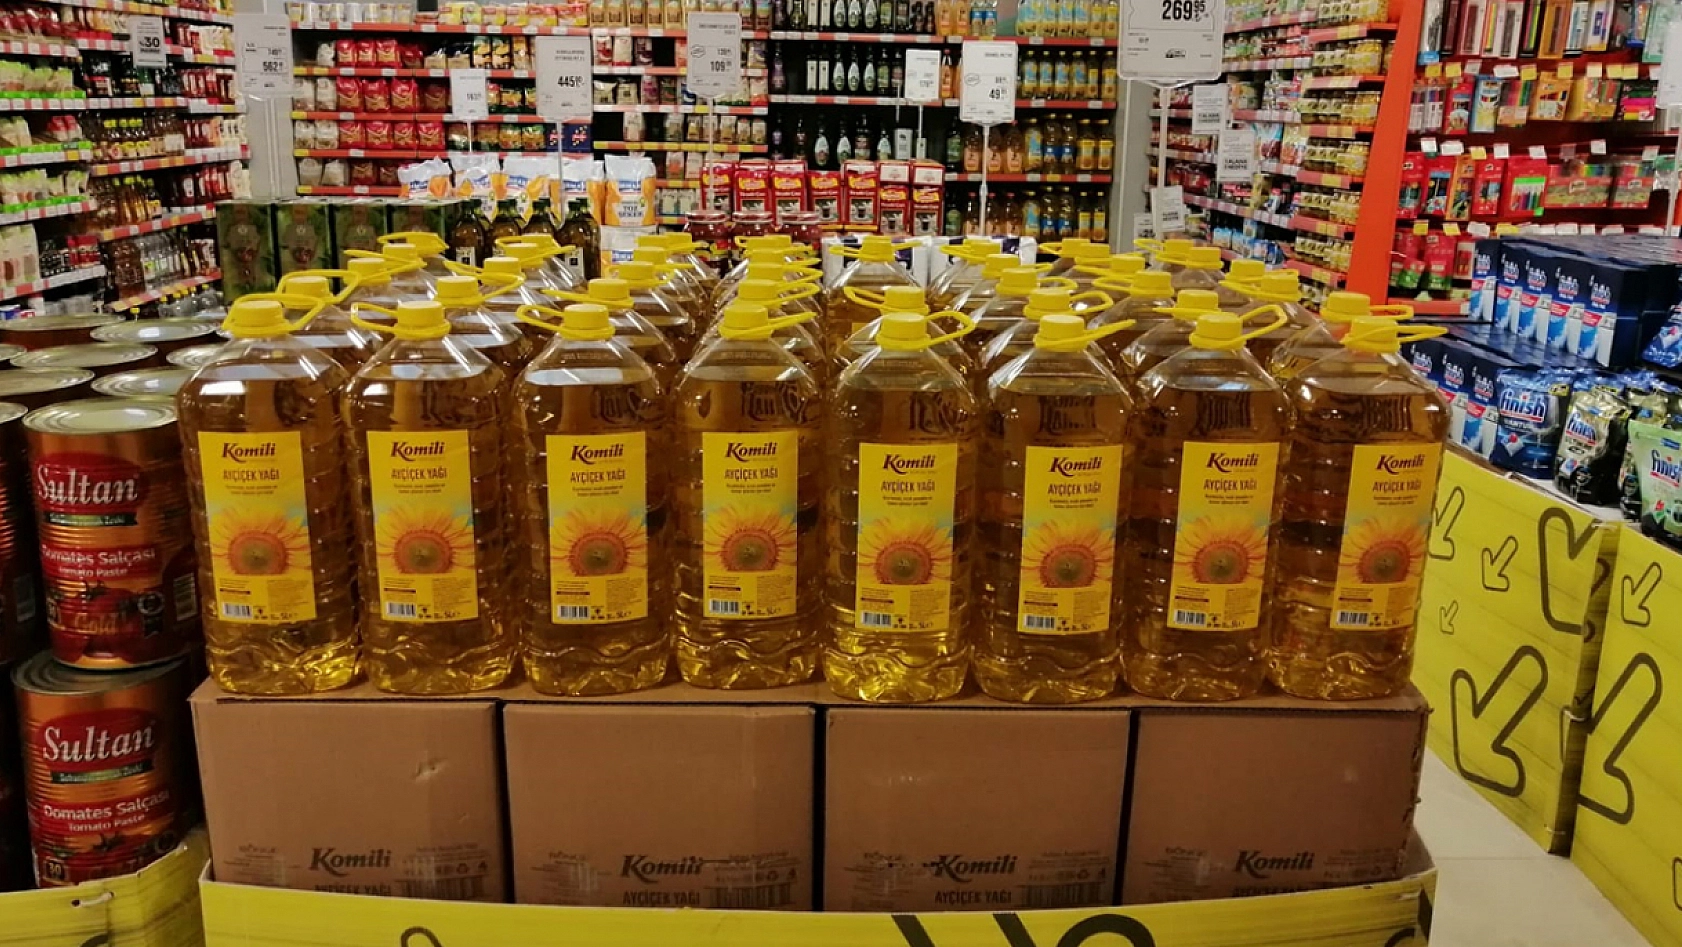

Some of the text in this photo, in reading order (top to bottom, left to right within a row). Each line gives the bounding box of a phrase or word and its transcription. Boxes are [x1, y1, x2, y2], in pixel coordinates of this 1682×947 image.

[1162, 0, 1193, 20] 269
[1500, 387, 1546, 418] finish
[222, 442, 276, 463] Komili
[391, 441, 445, 462] Komili
[570, 443, 624, 465] Komili
[725, 441, 778, 463] Komili
[883, 453, 936, 475] Komili
[1048, 456, 1102, 477] Komili
[1206, 452, 1259, 473] Komili
[1375, 453, 1426, 475] Komili
[37, 464, 138, 505] Sultan
[570, 468, 626, 485] AYÇİÇEK YAĞI
[881, 479, 915, 493] AYÇİÇEK
[1047, 482, 1081, 497] AYÇİÇEK
[99, 547, 157, 567] Salçası
[42, 725, 155, 762] Sultan
[43, 790, 170, 822] Domates Salçası
[68, 814, 146, 832] Tomato Paste
[308, 848, 392, 878] Komili
[620, 855, 704, 885] Komili
[934, 854, 1019, 883] Komili
[1233, 850, 1316, 879] Komili
[622, 889, 701, 906] AYÇİÇEK YAĞI
[934, 888, 1012, 907] AYÇİÇEK YAĞI
